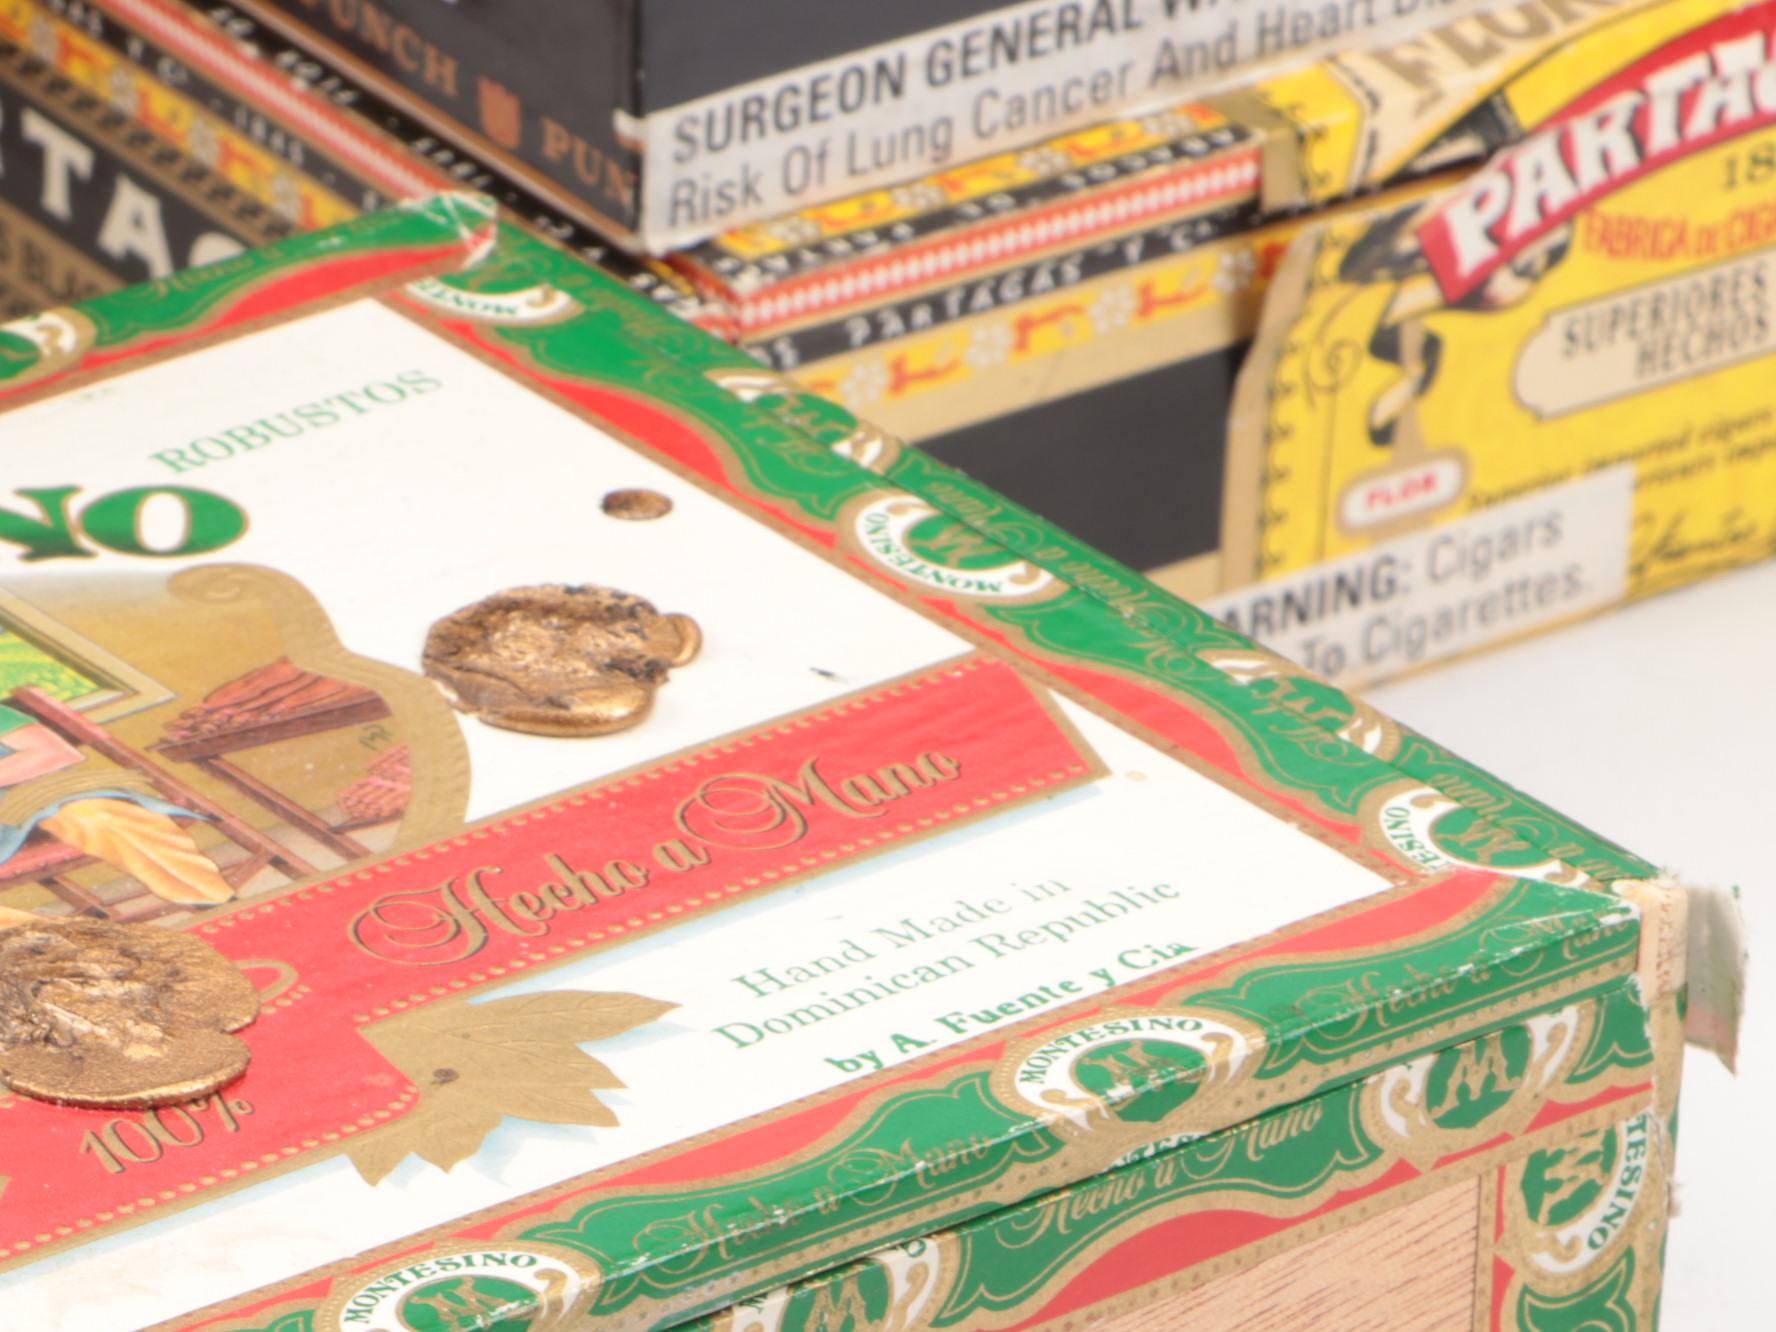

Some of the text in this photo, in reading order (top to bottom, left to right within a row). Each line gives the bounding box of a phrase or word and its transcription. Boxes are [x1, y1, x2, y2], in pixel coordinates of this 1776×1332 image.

[314, 0, 460, 97] UNCH
[673, 0, 1144, 165] SURGEON GENERAL
[667, 162, 764, 229] Risk
[782, 137, 831, 197] Of
[846, 115, 953, 178] Lung
[972, 58, 1139, 140] Cancer
[1150, 17, 1238, 90] And
[1257, 0, 1377, 56] Heart
[1633, 308, 1772, 380] HECHOS
[149, 368, 444, 475] ROBUSTOS
[864, 511, 1004, 594] MONTESINO
[1427, 508, 1565, 585] Cigars
[1299, 636, 1345, 678] To
[347, 745, 963, 967] Hecho a Mano
[709, 878, 1184, 1051] Dominican Republic
[731, 877, 1074, 999] Hand Made in
[824, 937, 1201, 1077] by A. Fuente y Cia
[1019, 1016, 1204, 1085] MONTESINO
[78, 1088, 258, 1175] 100%
[344, 1252, 538, 1325] MONTESINO
